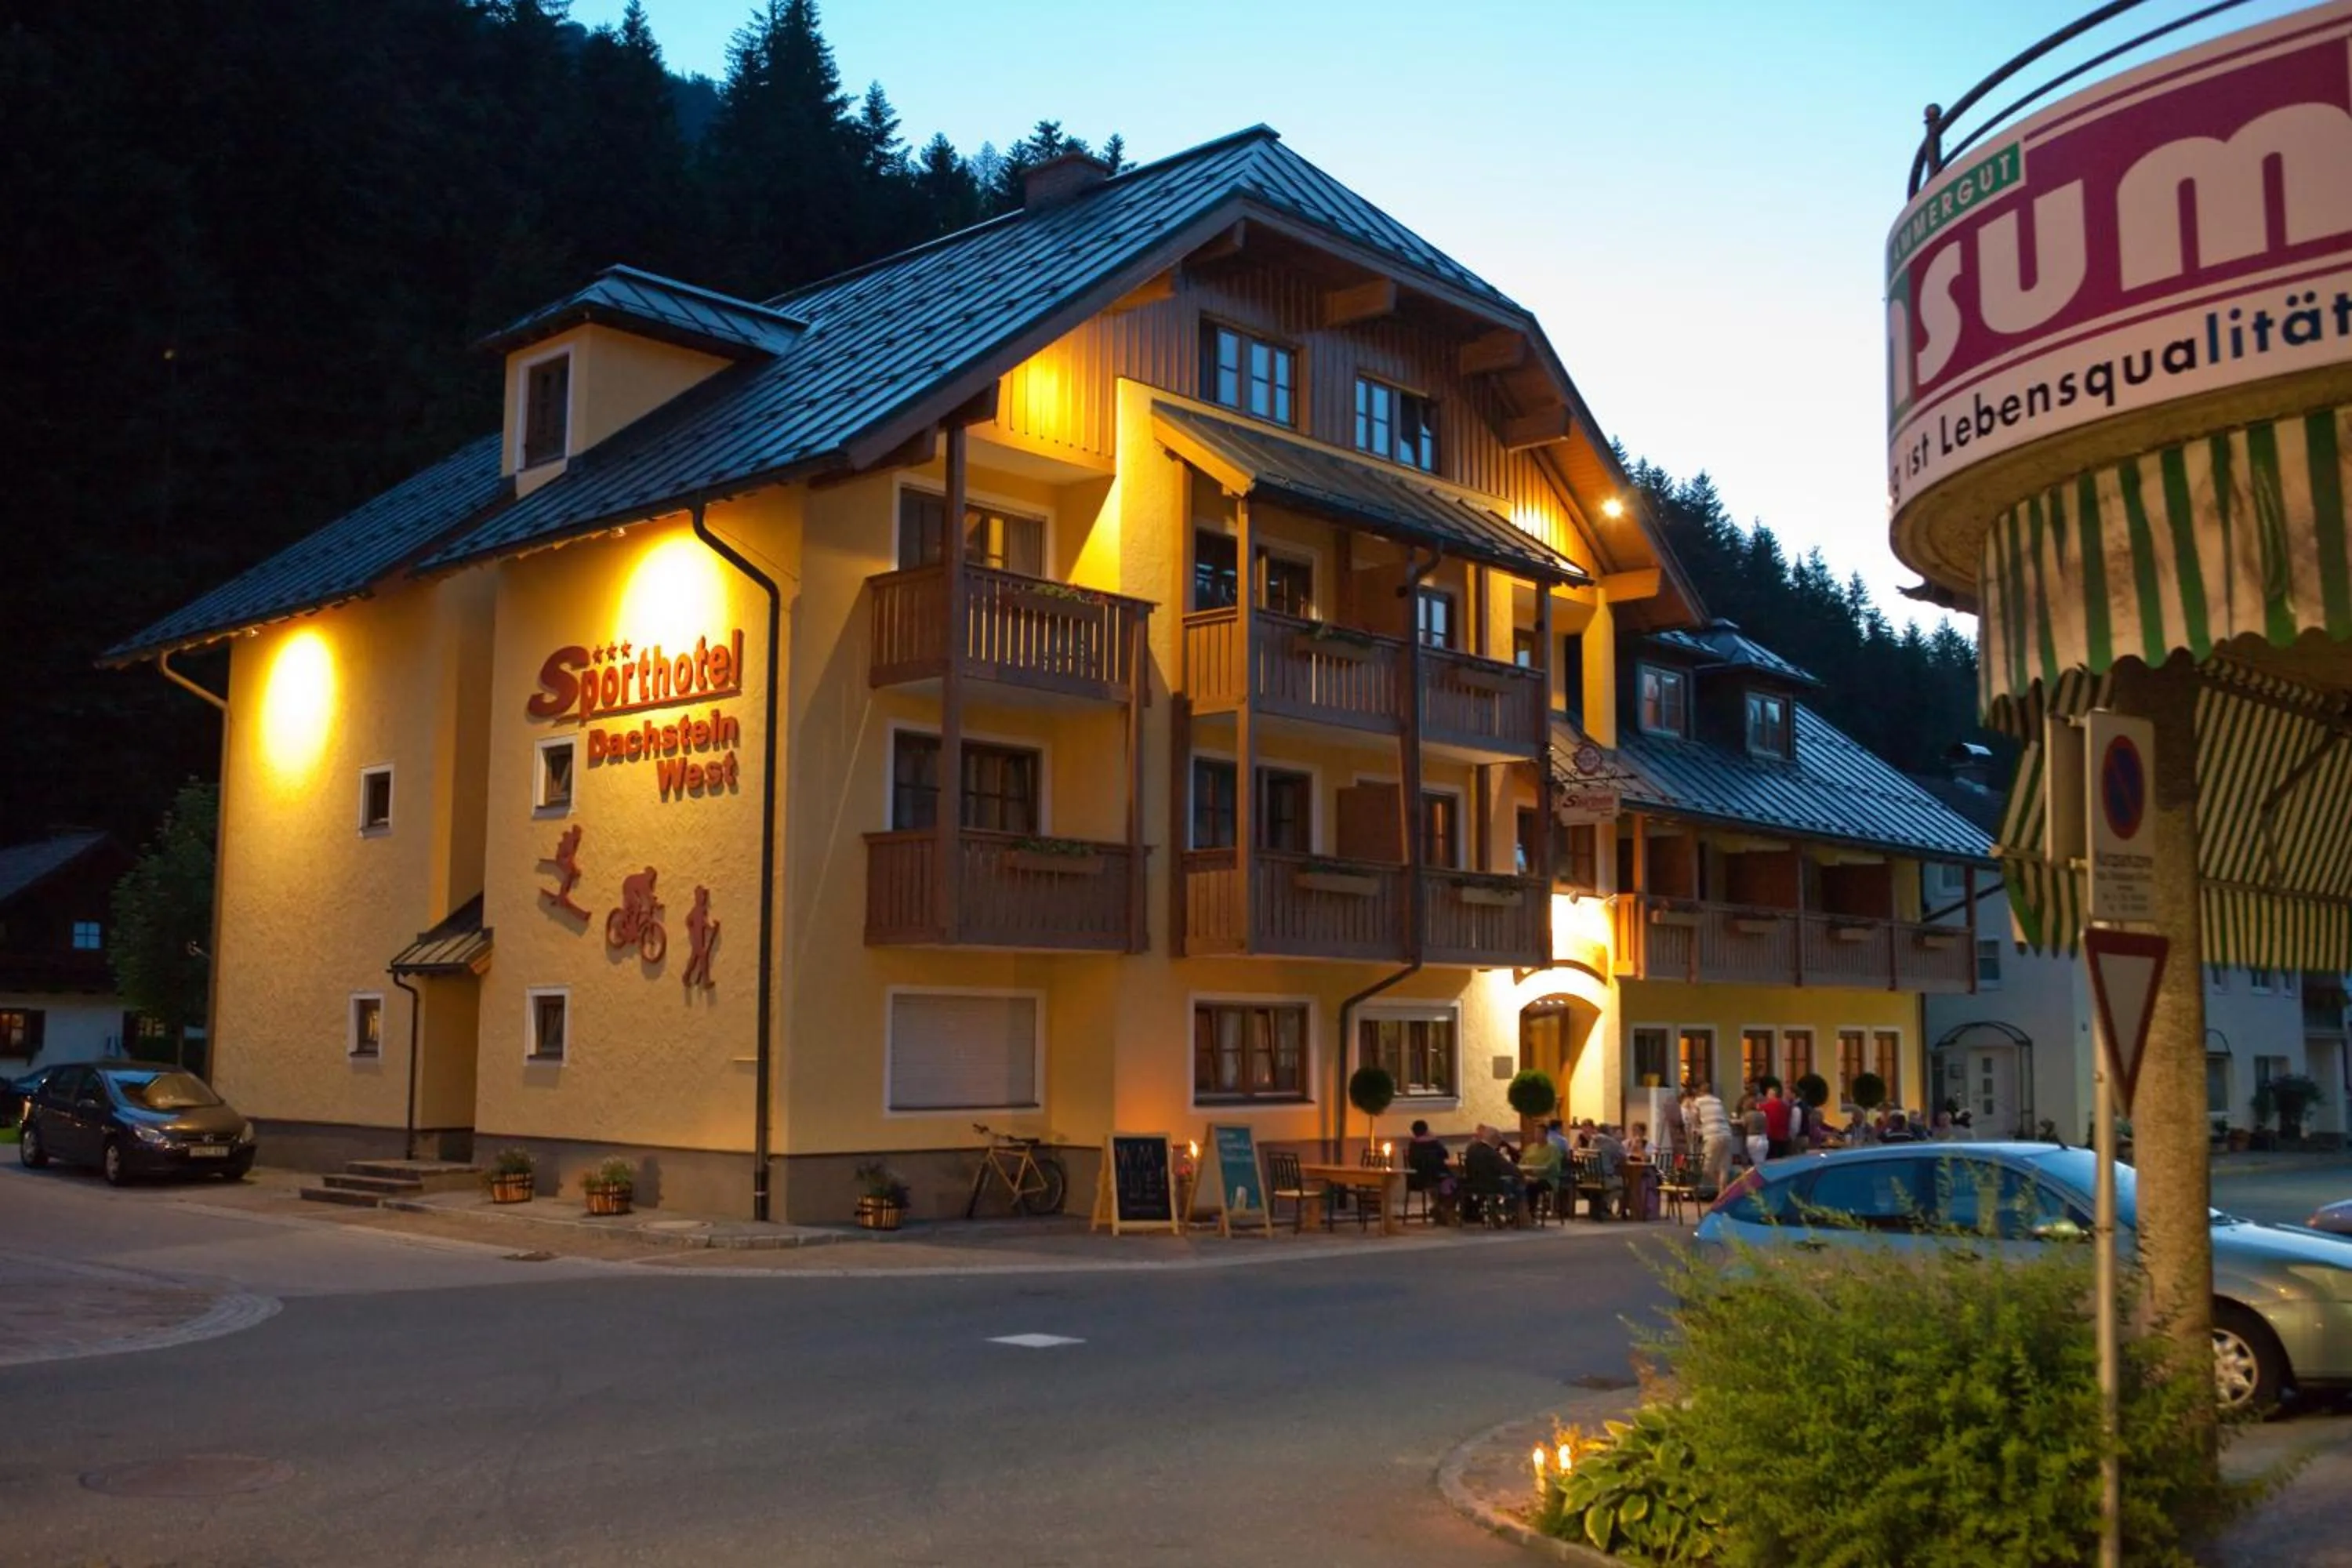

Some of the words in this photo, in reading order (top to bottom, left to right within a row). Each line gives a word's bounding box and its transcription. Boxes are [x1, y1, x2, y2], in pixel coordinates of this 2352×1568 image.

[1905, 431, 1929, 481] ist
[1940, 290, 2352, 456] Lebensqualität
[527, 628, 744, 720] Sporthotel
[588, 708, 739, 762] Dachstein
[656, 750, 738, 798] West
